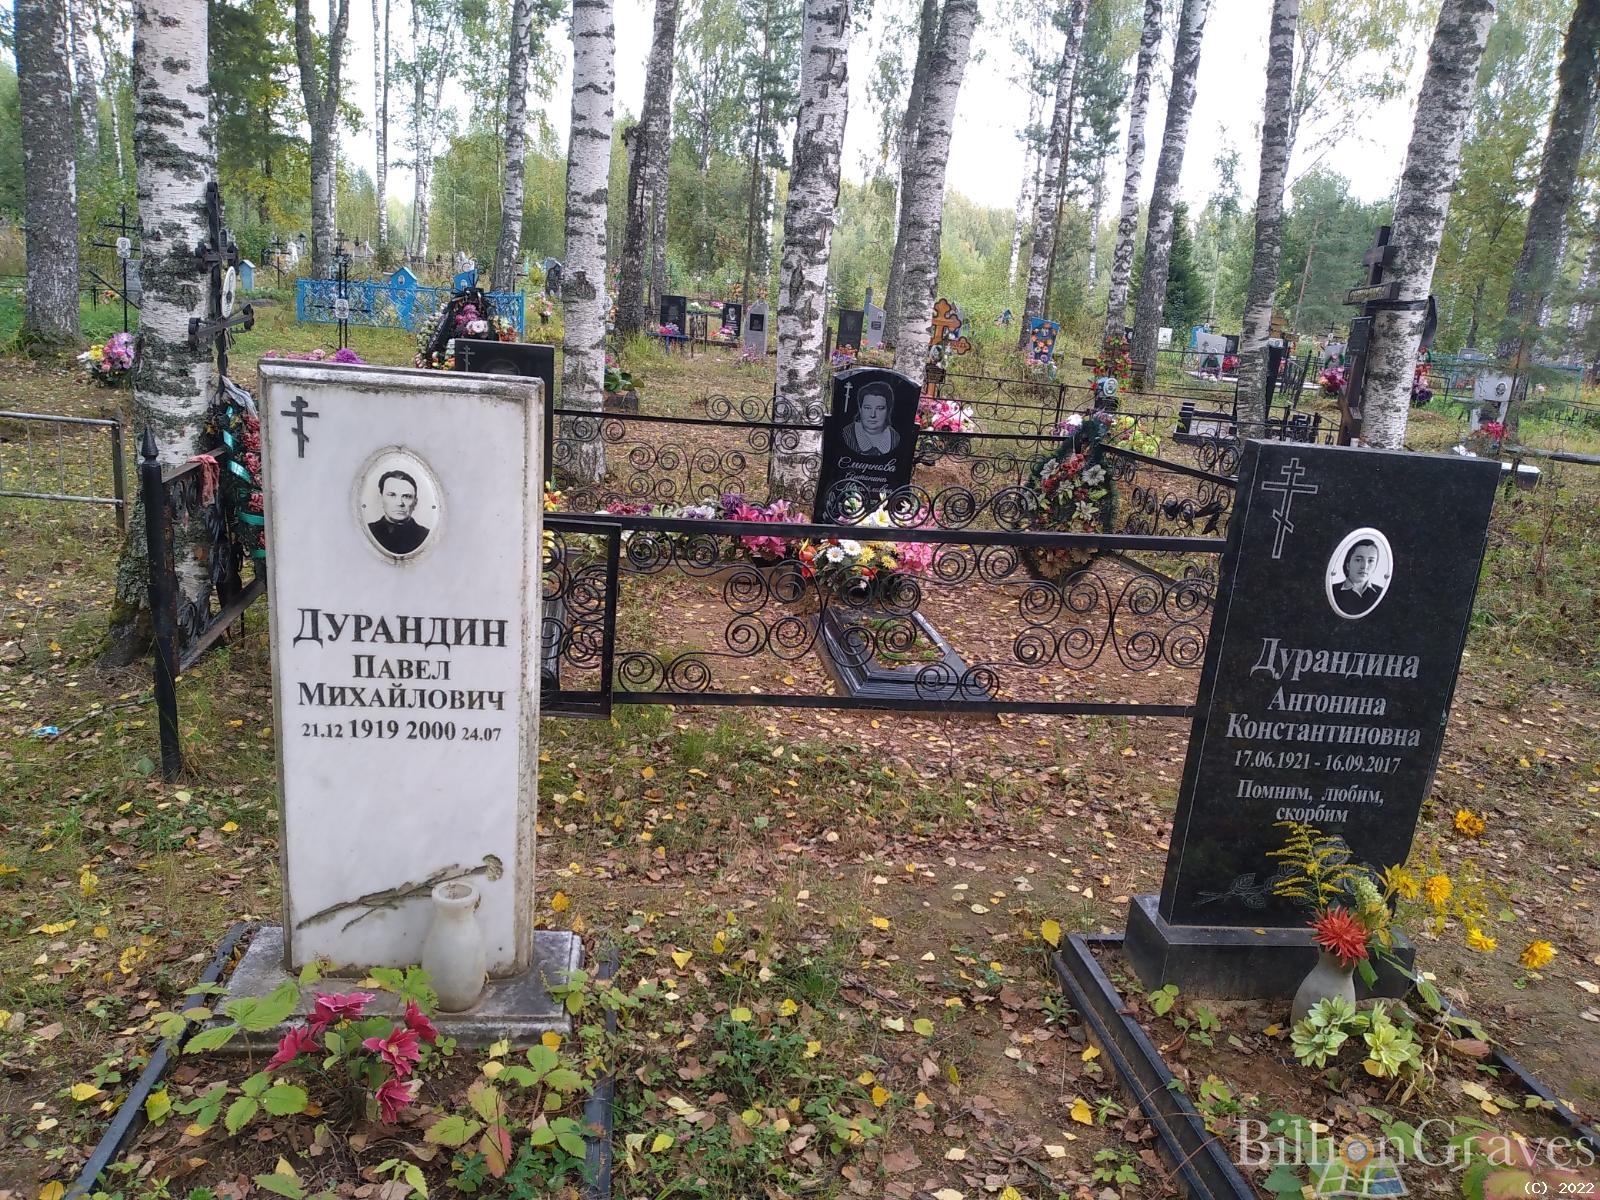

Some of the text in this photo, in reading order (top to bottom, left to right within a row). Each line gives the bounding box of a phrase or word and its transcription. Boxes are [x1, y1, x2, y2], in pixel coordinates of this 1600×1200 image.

[838, 456, 897, 473] Смирнова
[293, 608, 508, 653] ДУРАНДИН
[352, 654, 451, 680] ПАВЕЛ
[1250, 638, 1420, 681] Дурандина
[297, 682, 505, 710] МИХАЙЛОВИЧ
[1267, 686, 1387, 716] Антонина
[302, 719, 501, 741] 21.12 1919 2000 24.07
[1225, 712, 1421, 747] Константиновна
[1234, 750, 1310, 769] 17.06.1921
[1324, 755, 1401, 774] 16.09.2017
[1236, 779, 1384, 806] Помним, любим,
[1276, 805, 1349, 824] скорбим
